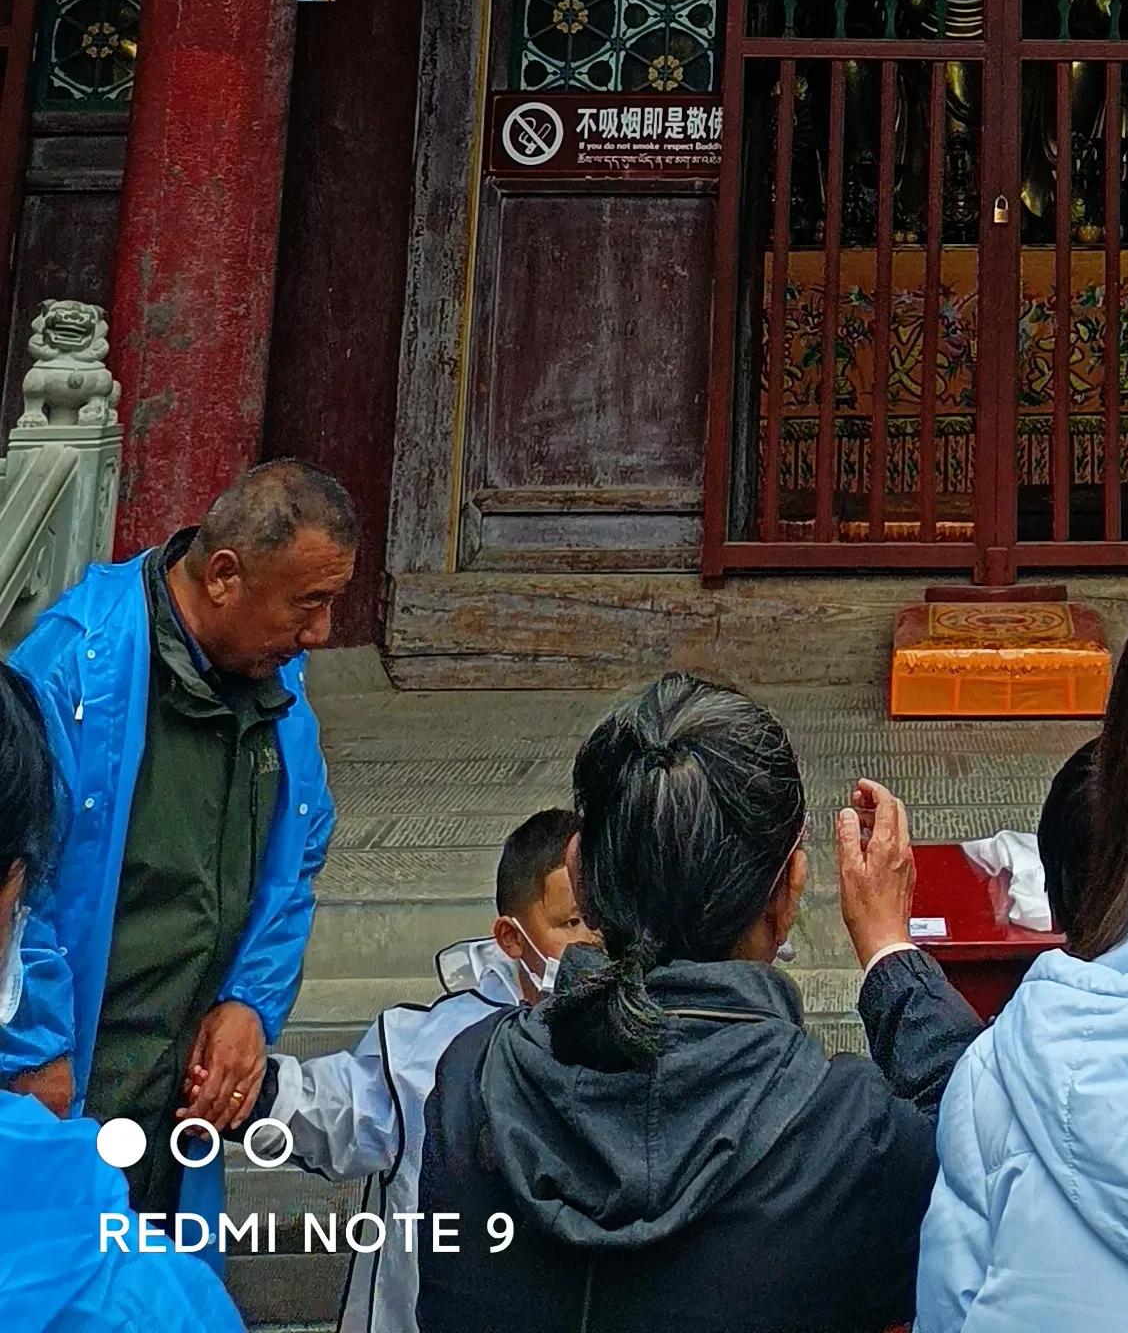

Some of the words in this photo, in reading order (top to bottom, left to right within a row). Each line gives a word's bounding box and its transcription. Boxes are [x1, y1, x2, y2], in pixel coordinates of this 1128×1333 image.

[586, 143, 602, 152] you
[603, 142, 615, 150] do
[616, 142, 631, 150] not
[632, 142, 660, 150] smoke
[663, 142, 694, 152] respect
